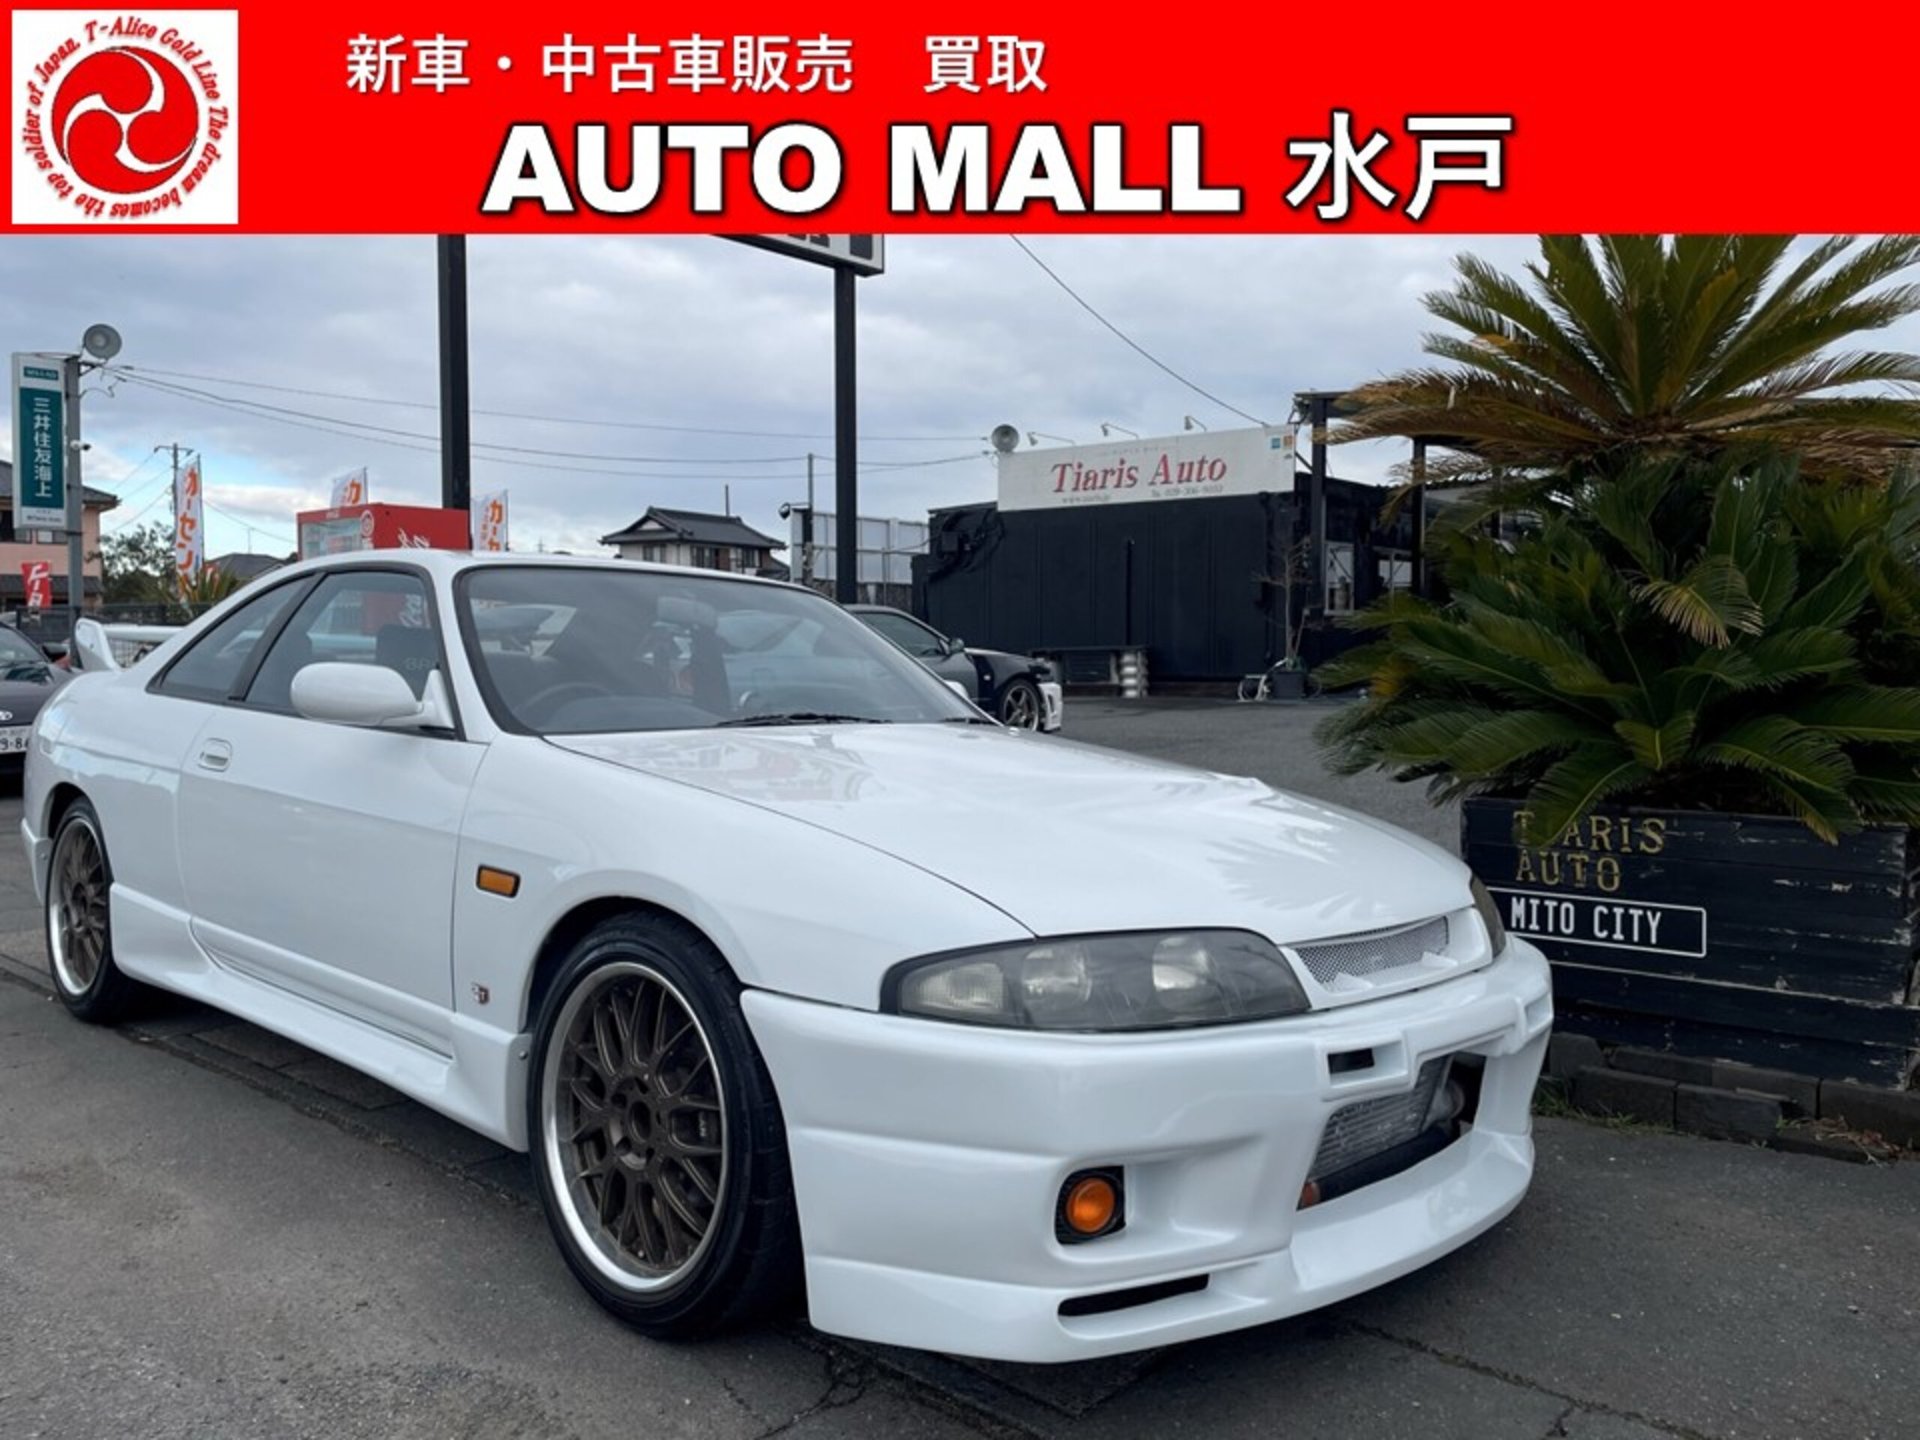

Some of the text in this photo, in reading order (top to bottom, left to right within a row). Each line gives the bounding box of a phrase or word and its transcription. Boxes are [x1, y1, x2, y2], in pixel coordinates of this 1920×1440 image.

[33, 398, 52, 498] 三井住友海上
[1051, 453, 1228, 493] Tiaris Auto
[1513, 811, 1666, 854] TARIS
[1516, 850, 1622, 892] AUTO
[1511, 896, 1662, 945] MITO CITY
